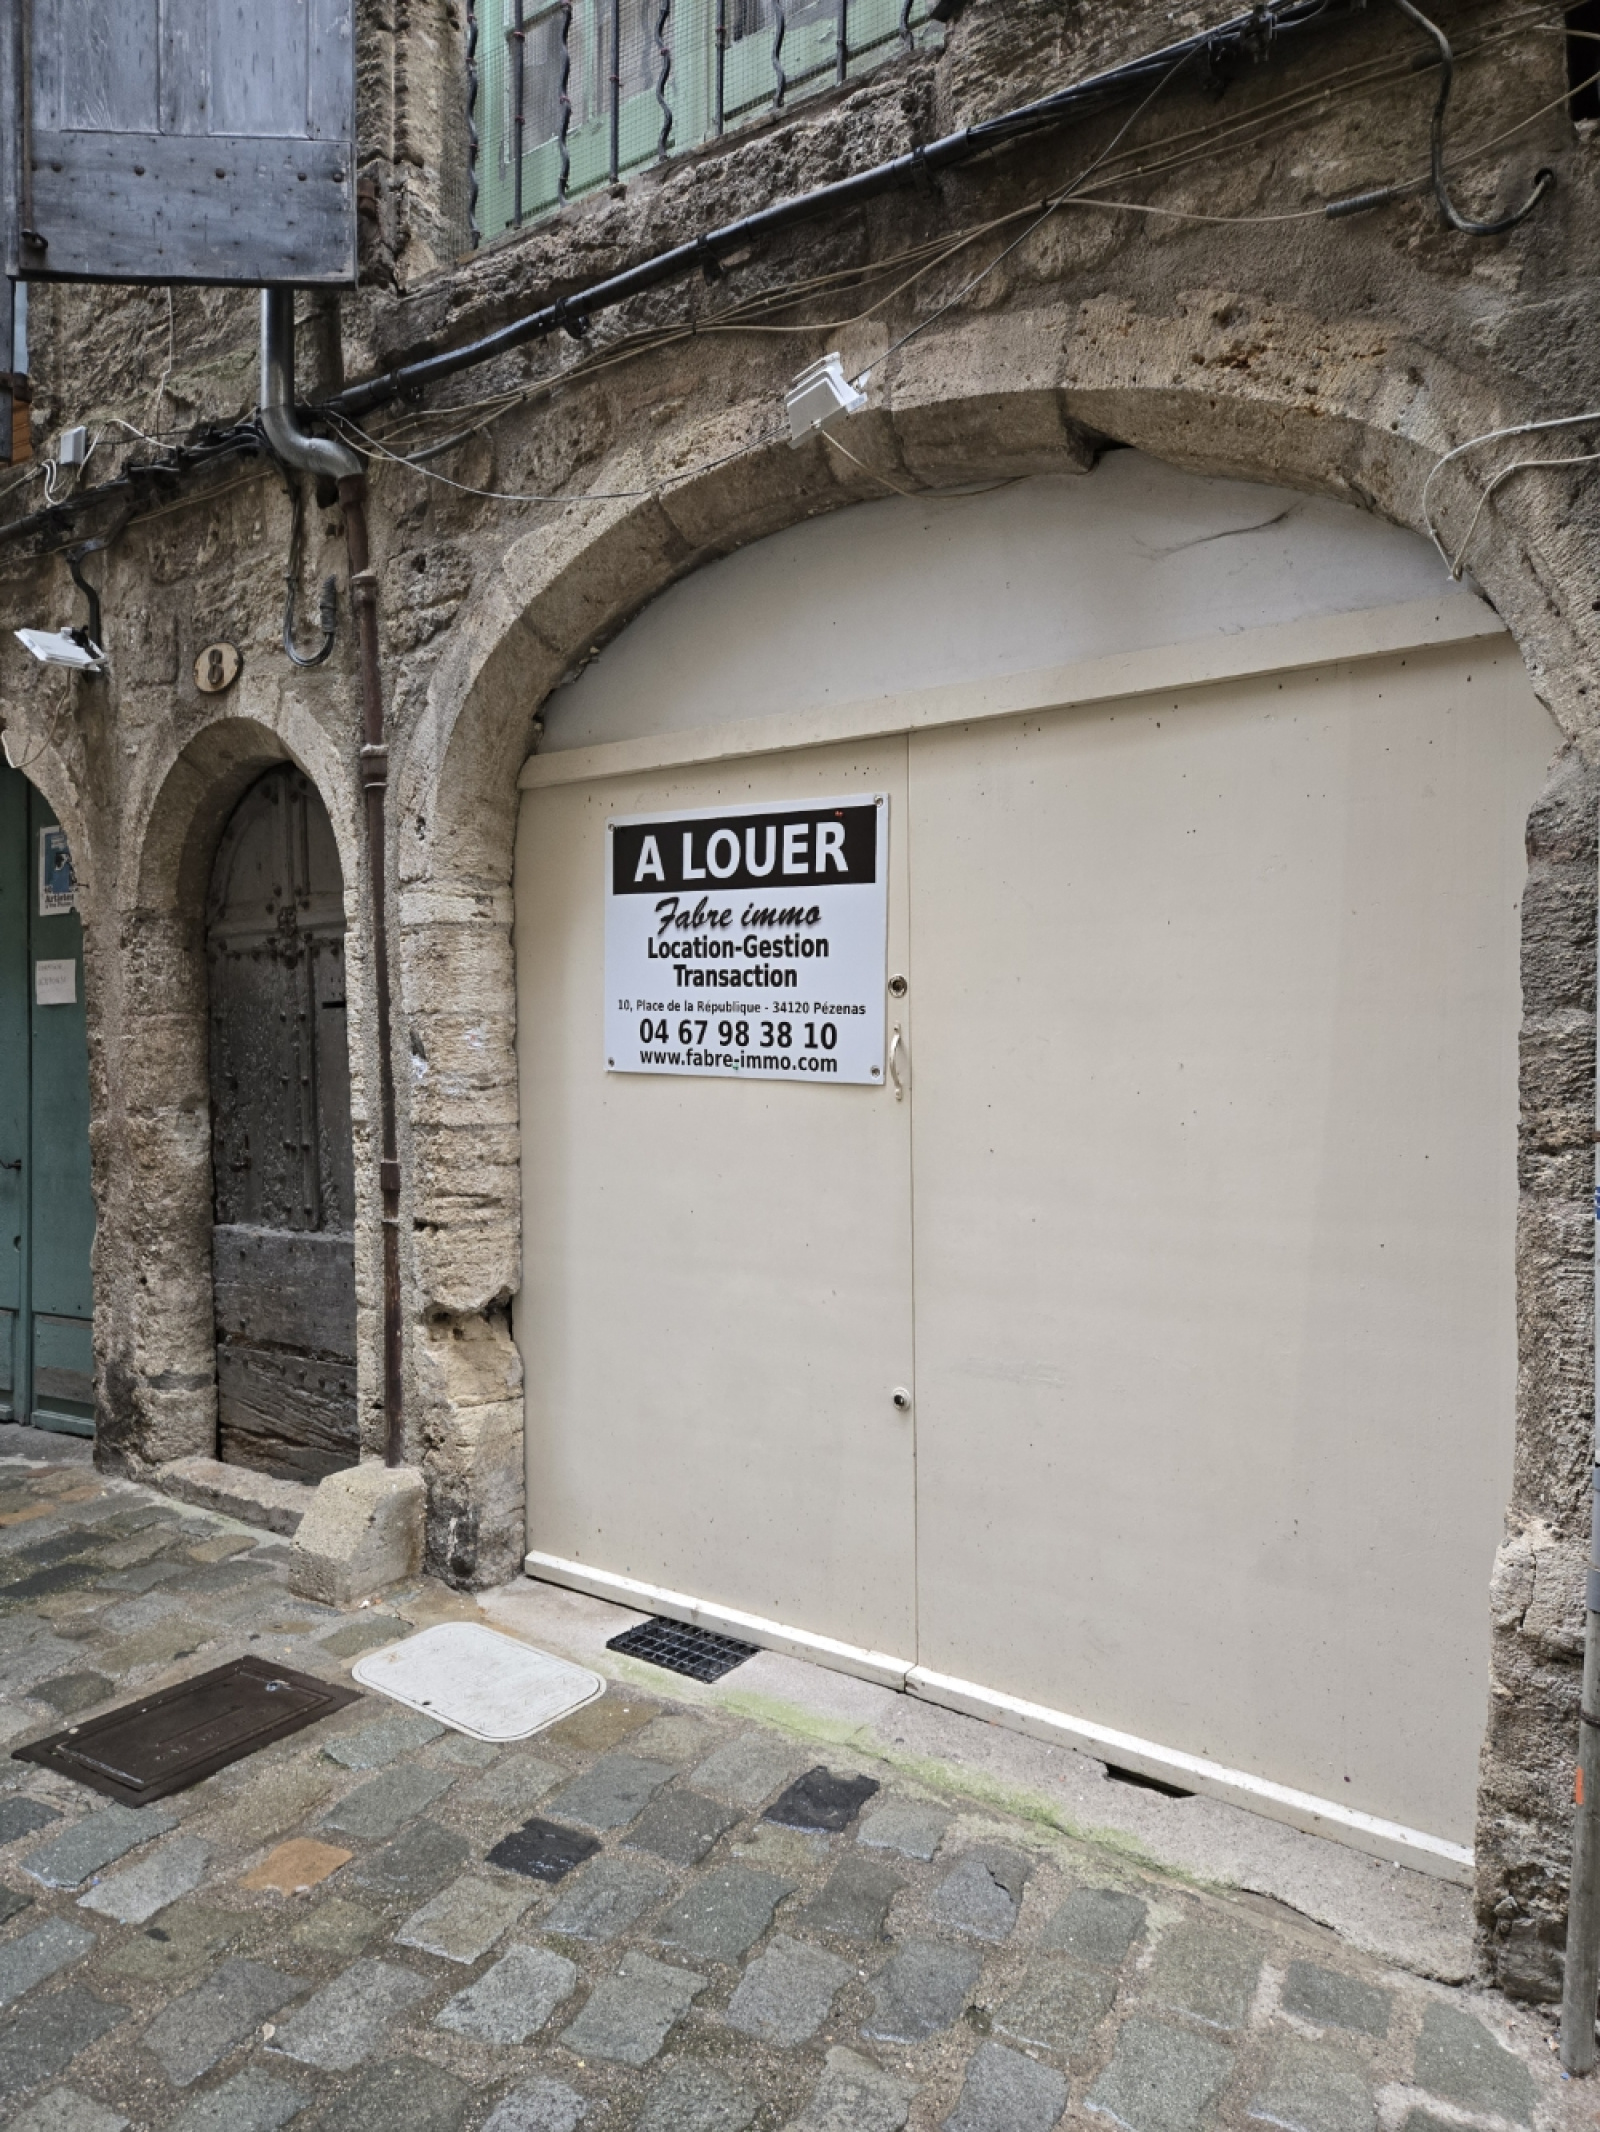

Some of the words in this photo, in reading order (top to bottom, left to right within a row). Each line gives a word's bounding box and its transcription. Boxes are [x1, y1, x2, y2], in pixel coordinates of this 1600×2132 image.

[208, 648, 224, 685] 8
[633, 834, 666, 883] A
[682, 820, 849, 881] LOUER
[654, 896, 734, 936] Fabre
[740, 902, 822, 927] immo
[647, 933, 830, 959] Location-Gestion
[673, 963, 798, 988] Transaction
[618, 999, 633, 1012] 10,
[636, 999, 665, 1012] Place
[667, 1000, 681, 1012] de
[684, 1000, 694, 1012] la
[697, 1000, 761, 1016] République
[772, 1001, 810, 1014] 34120
[813, 1001, 866, 1015] Pézenas
[639, 1018, 669, 1044] 04
[678, 1019, 708, 1045] 67
[718, 1020, 750, 1047] 98
[759, 1021, 793, 1048] 38
[804, 1022, 838, 1050] 10
[639, 1048, 838, 1073] www.fabre-immo.com
